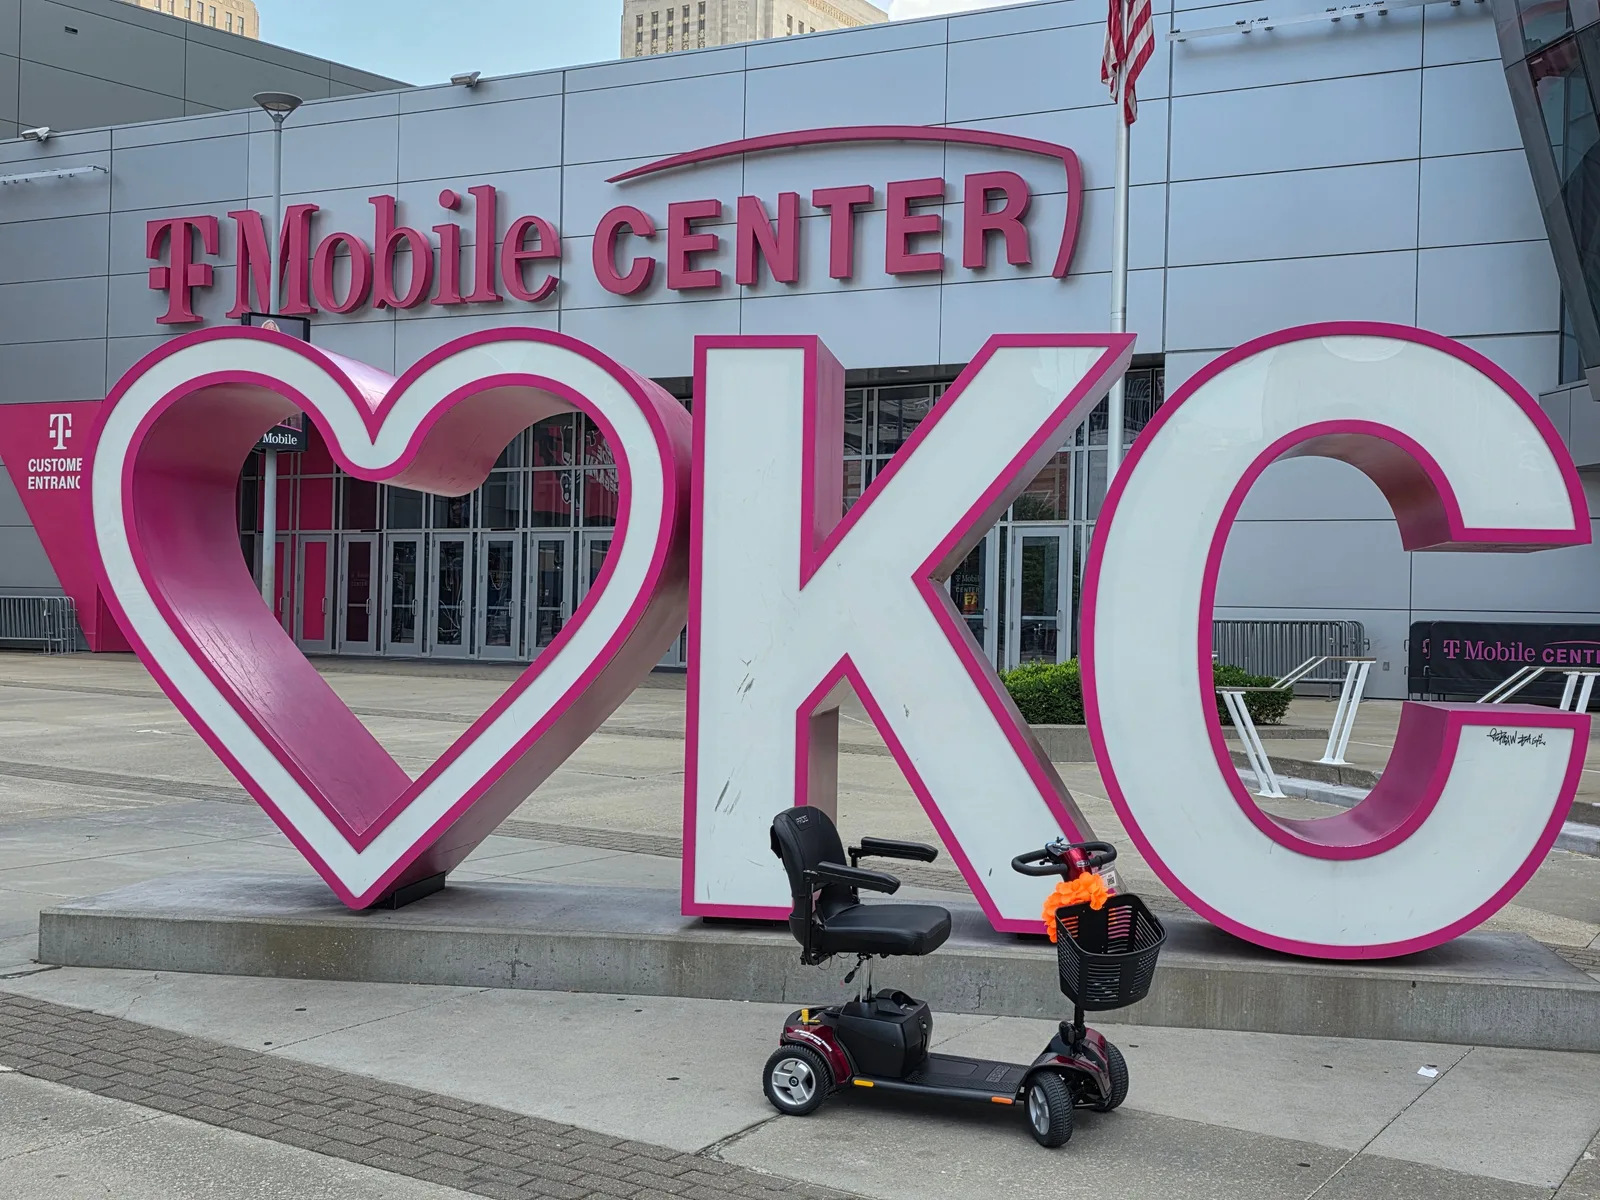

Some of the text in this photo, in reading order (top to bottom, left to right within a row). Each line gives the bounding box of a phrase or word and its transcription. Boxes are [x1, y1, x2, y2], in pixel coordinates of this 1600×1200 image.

[226, 184, 562, 319] Mobile
[592, 170, 1032, 296] CENTER
[262, 432, 298, 445] Mobile
[1464, 640, 1536, 662] Mobile
